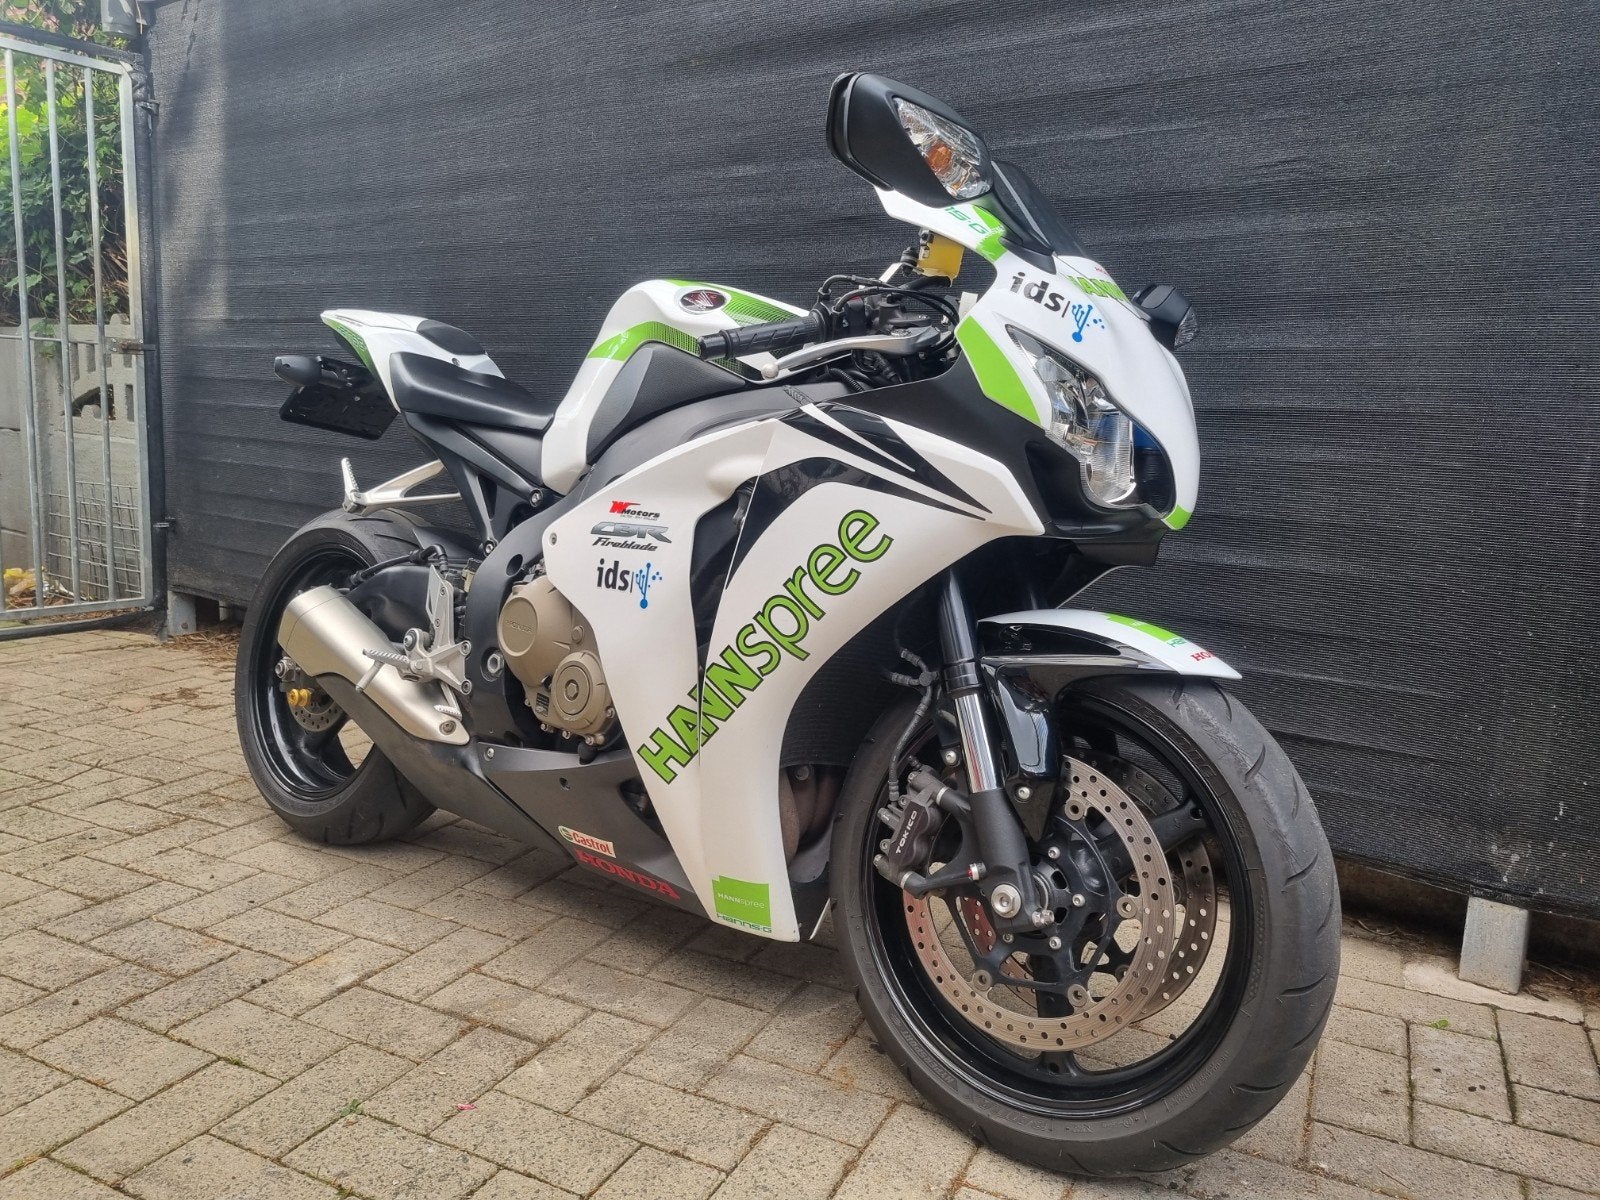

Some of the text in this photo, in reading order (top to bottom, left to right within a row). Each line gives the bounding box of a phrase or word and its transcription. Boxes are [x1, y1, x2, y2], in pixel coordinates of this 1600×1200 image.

[1011, 271, 1065, 312] ids
[591, 521, 672, 544] CBR
[592, 536, 658, 551] Fireblade
[597, 558, 630, 592] ids
[637, 509, 894, 784] HANNspree
[572, 832, 613, 855] Castrol
[895, 810, 917, 854] TOKICO
[574, 848, 680, 900] HONDA
